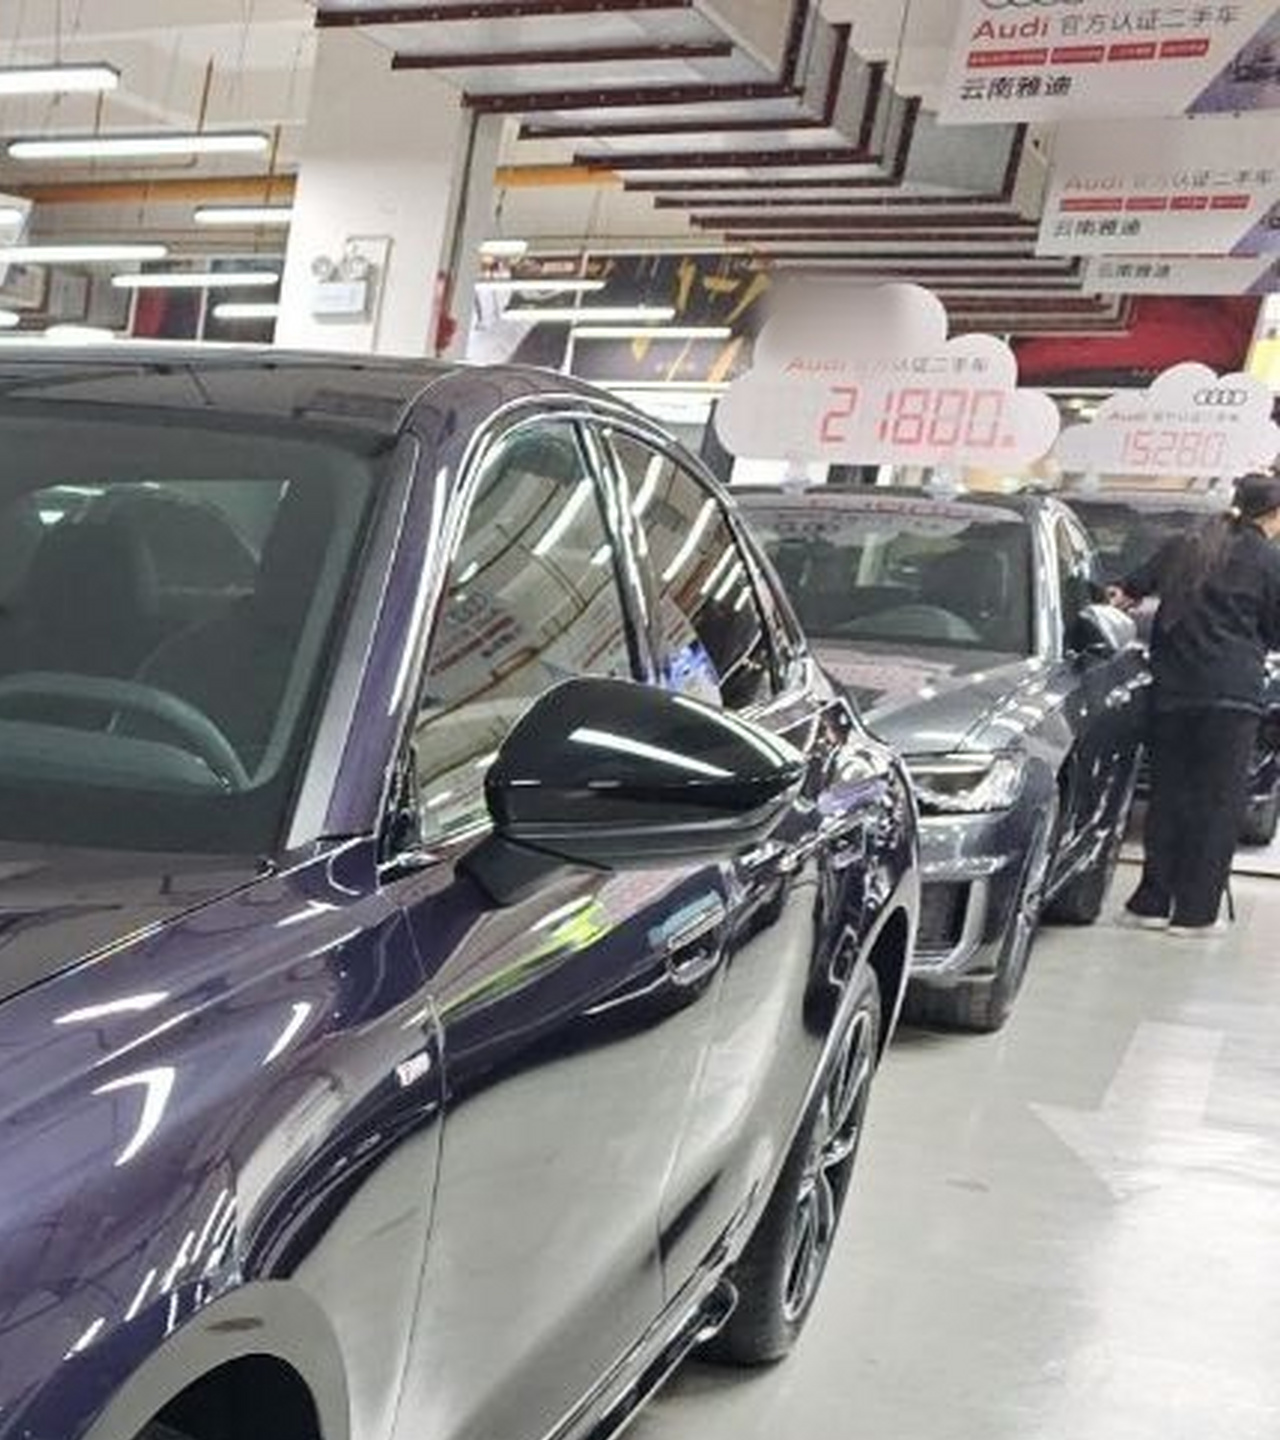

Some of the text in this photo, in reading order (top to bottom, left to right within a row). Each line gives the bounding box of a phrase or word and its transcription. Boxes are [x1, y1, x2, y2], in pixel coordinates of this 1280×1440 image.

[970, 5, 1239, 40] Audi 官方认证二手车
[1064, 172, 1125, 191] Audi
[785, 357, 848, 374] Audi
